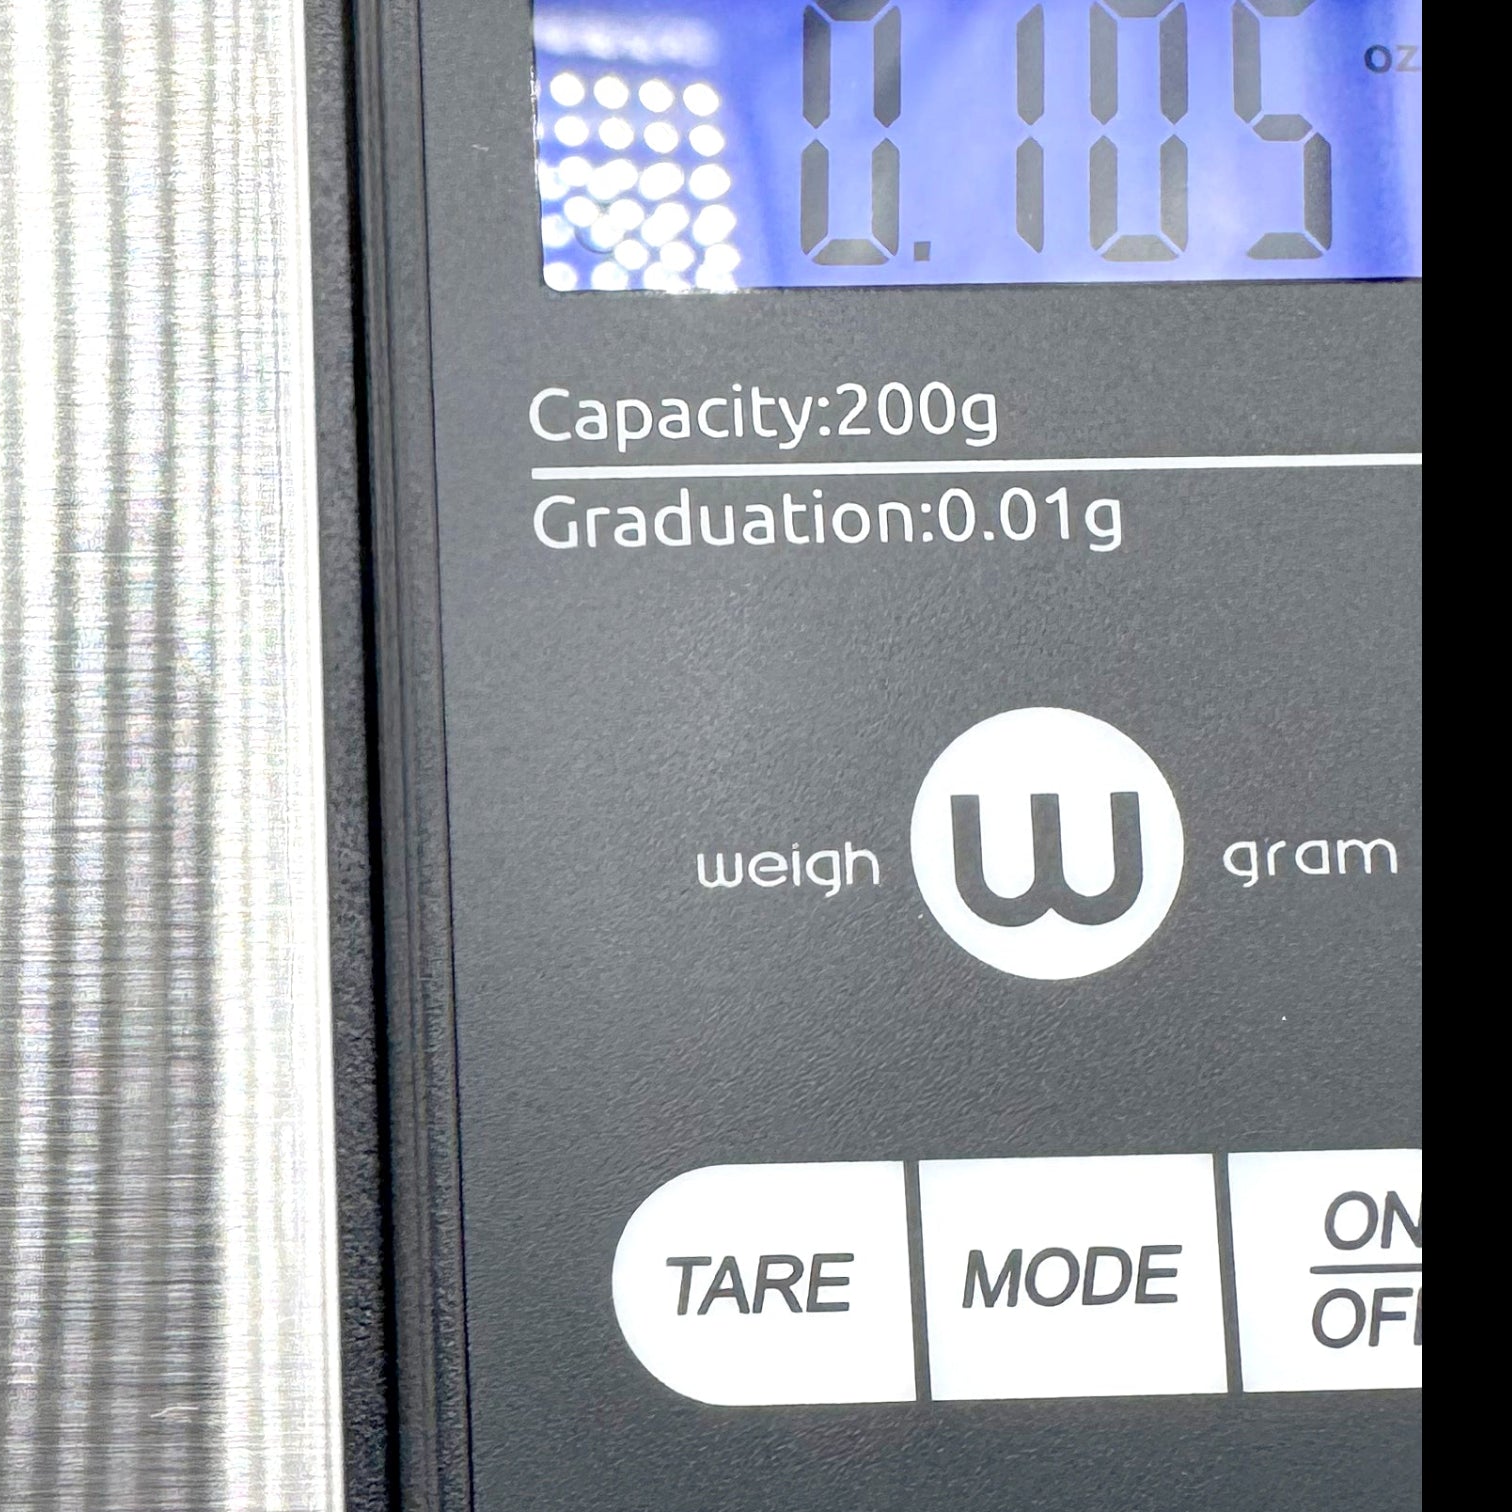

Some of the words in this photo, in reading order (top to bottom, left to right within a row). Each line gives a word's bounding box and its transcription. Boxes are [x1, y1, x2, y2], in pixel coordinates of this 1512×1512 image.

[528, 381, 999, 452] Capacity:200g
[532, 486, 1123, 553] Graduation:0.01g
[695, 841, 882, 899] weigh
[1222, 836, 1399, 888] gram
[1324, 1190, 1422, 1251] ON
[666, 1252, 855, 1316] TARE
[962, 1244, 1183, 1309] MODE
